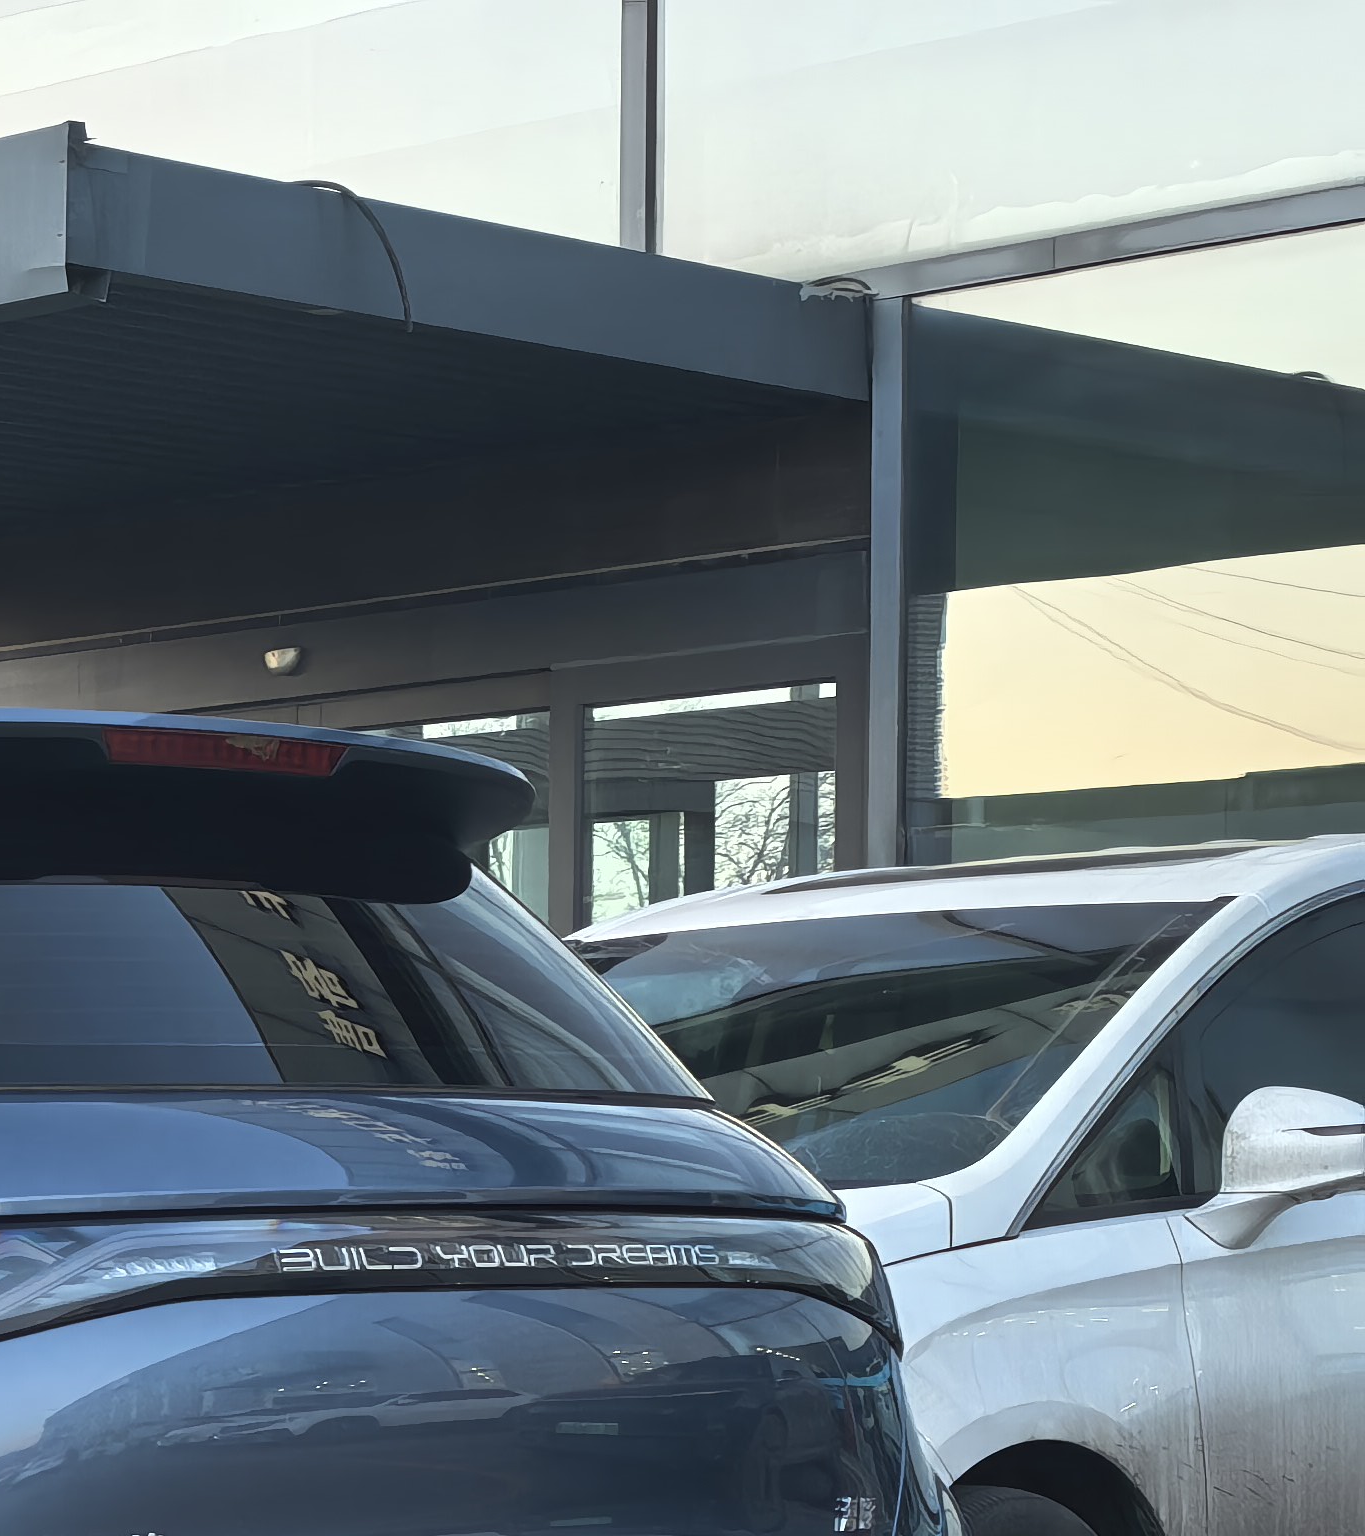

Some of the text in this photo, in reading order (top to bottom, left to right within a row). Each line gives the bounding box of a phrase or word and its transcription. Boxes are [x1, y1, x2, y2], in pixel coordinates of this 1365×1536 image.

[275, 1243, 720, 1273] BUILD YOUR DREAMS
